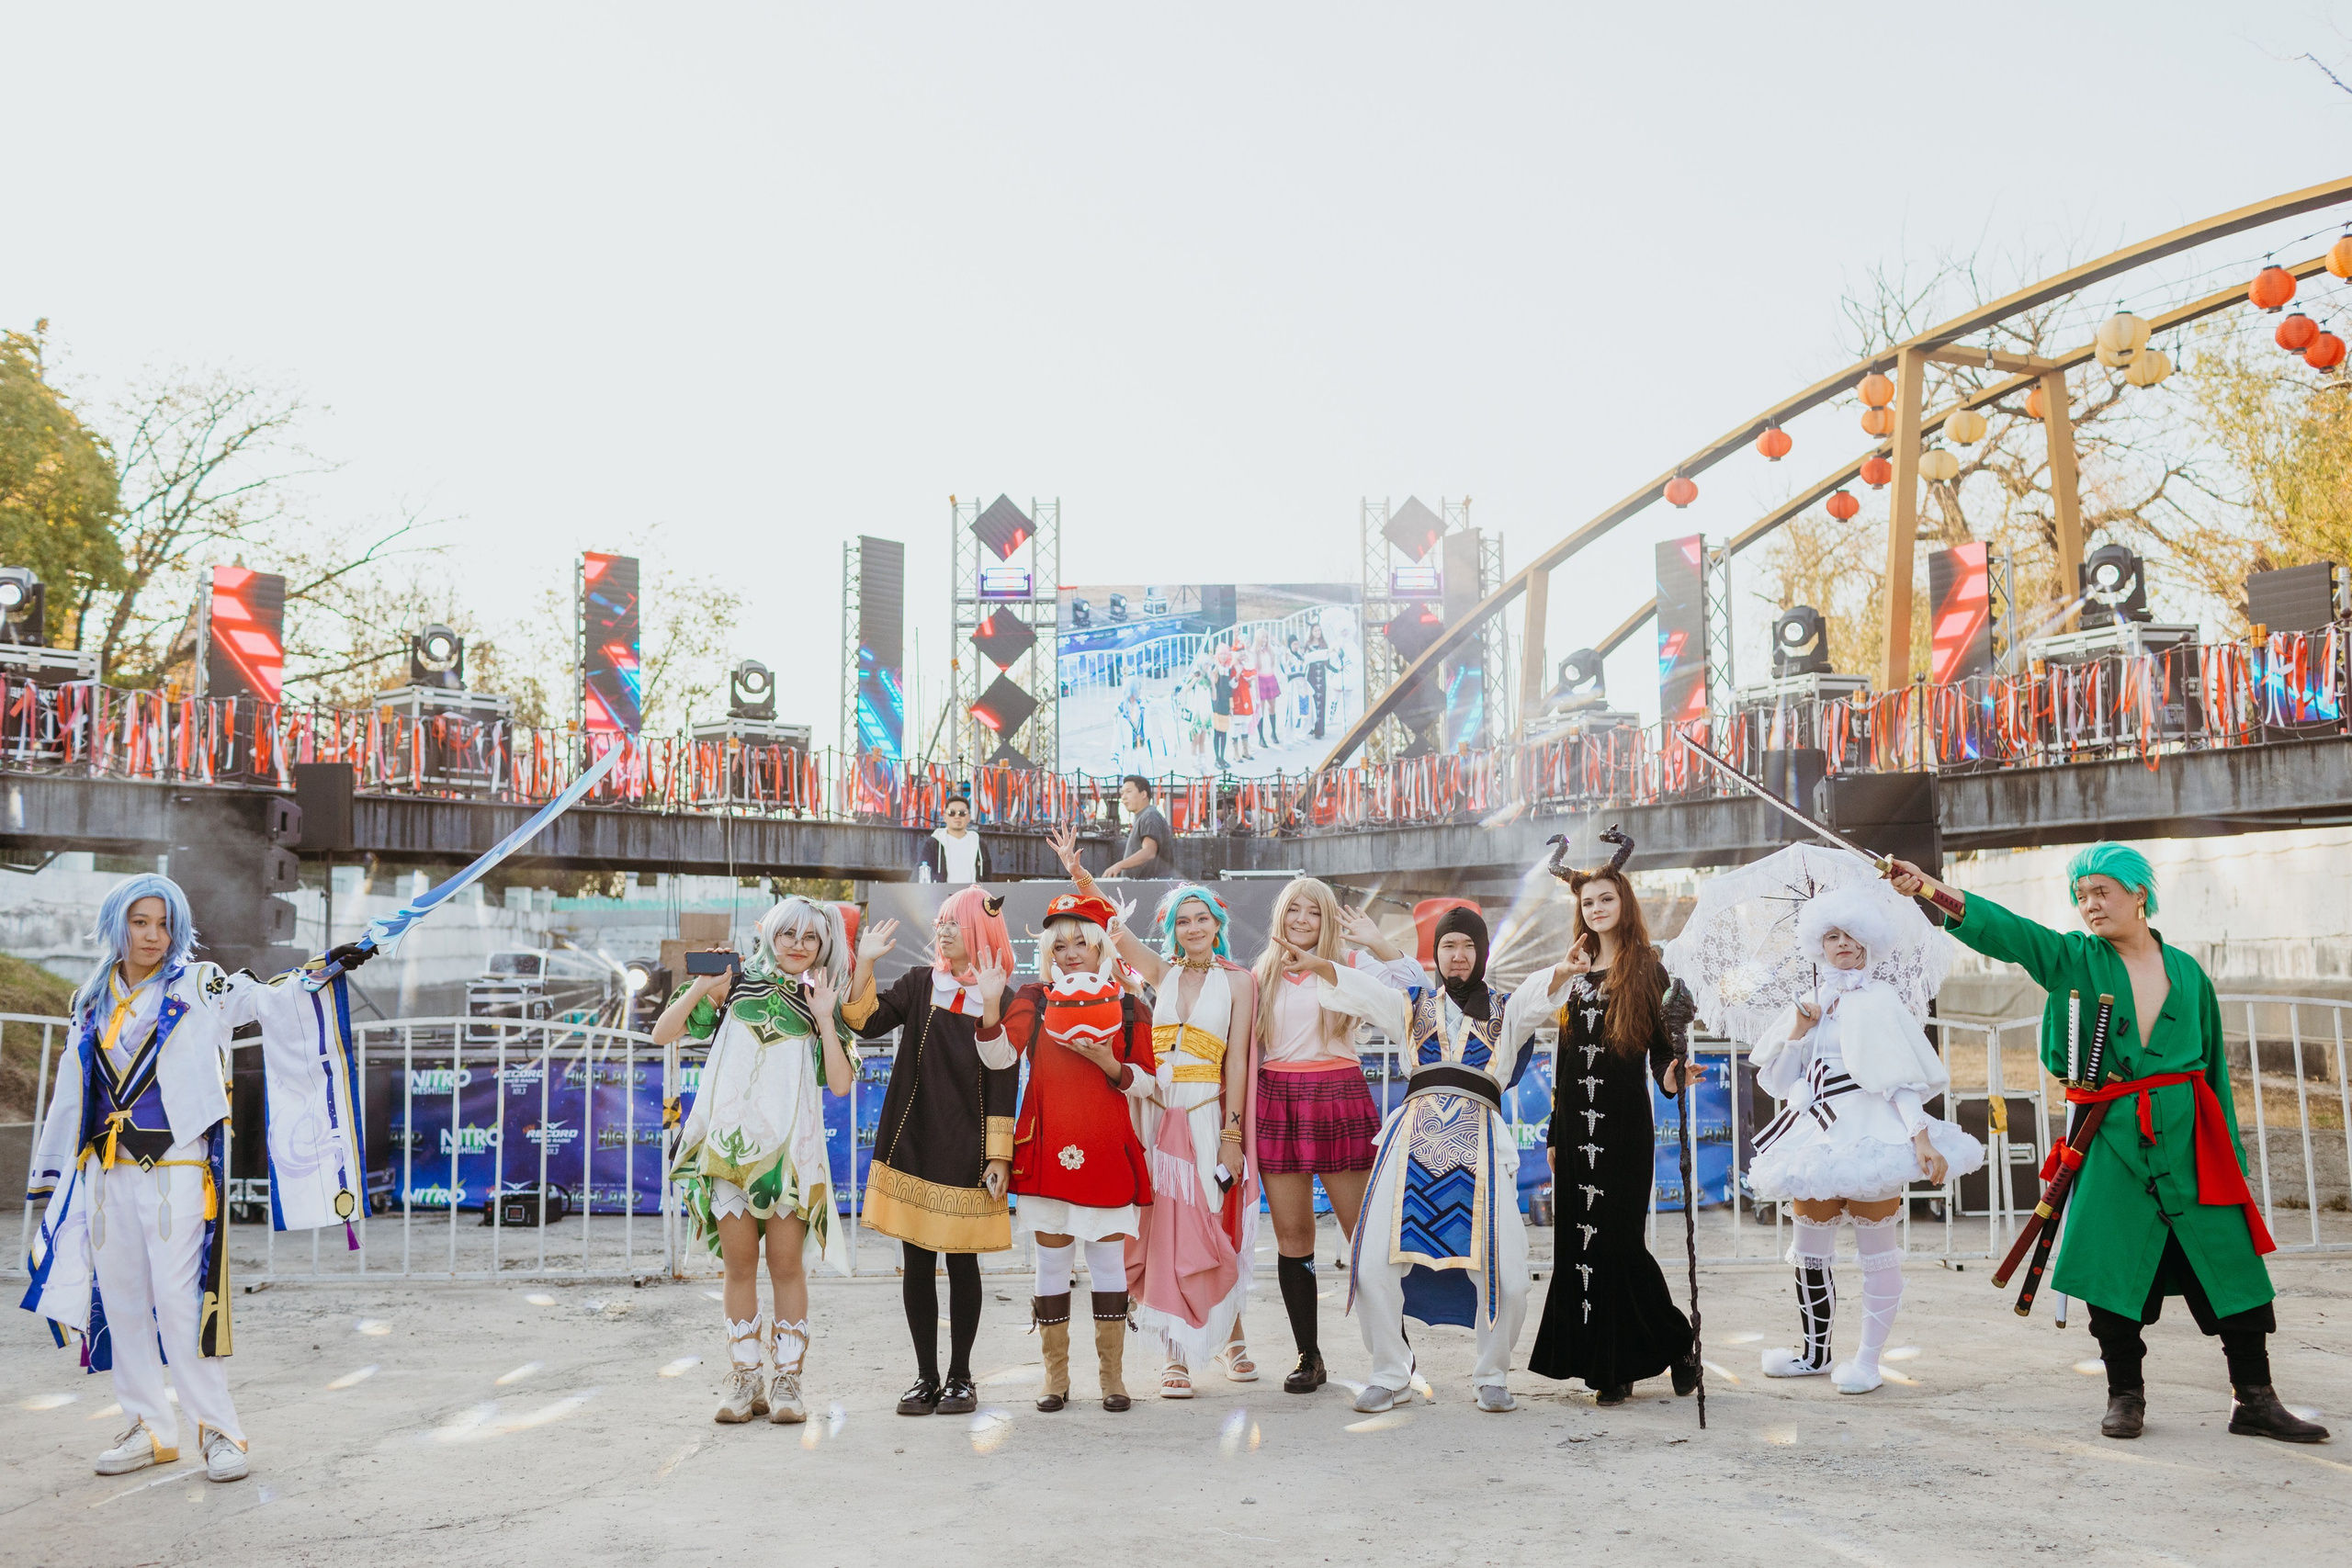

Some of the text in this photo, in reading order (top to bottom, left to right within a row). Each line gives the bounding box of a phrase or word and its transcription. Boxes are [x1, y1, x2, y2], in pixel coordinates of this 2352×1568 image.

[411, 1068, 472, 1088] NITRO
[492, 1069, 543, 1078] ECORD
[566, 1067, 647, 1086] HIGHLAD
[440, 1128, 504, 1147] NITRO
[526, 1129, 579, 1138] RECORD
[401, 1187, 467, 1203] NITRO
